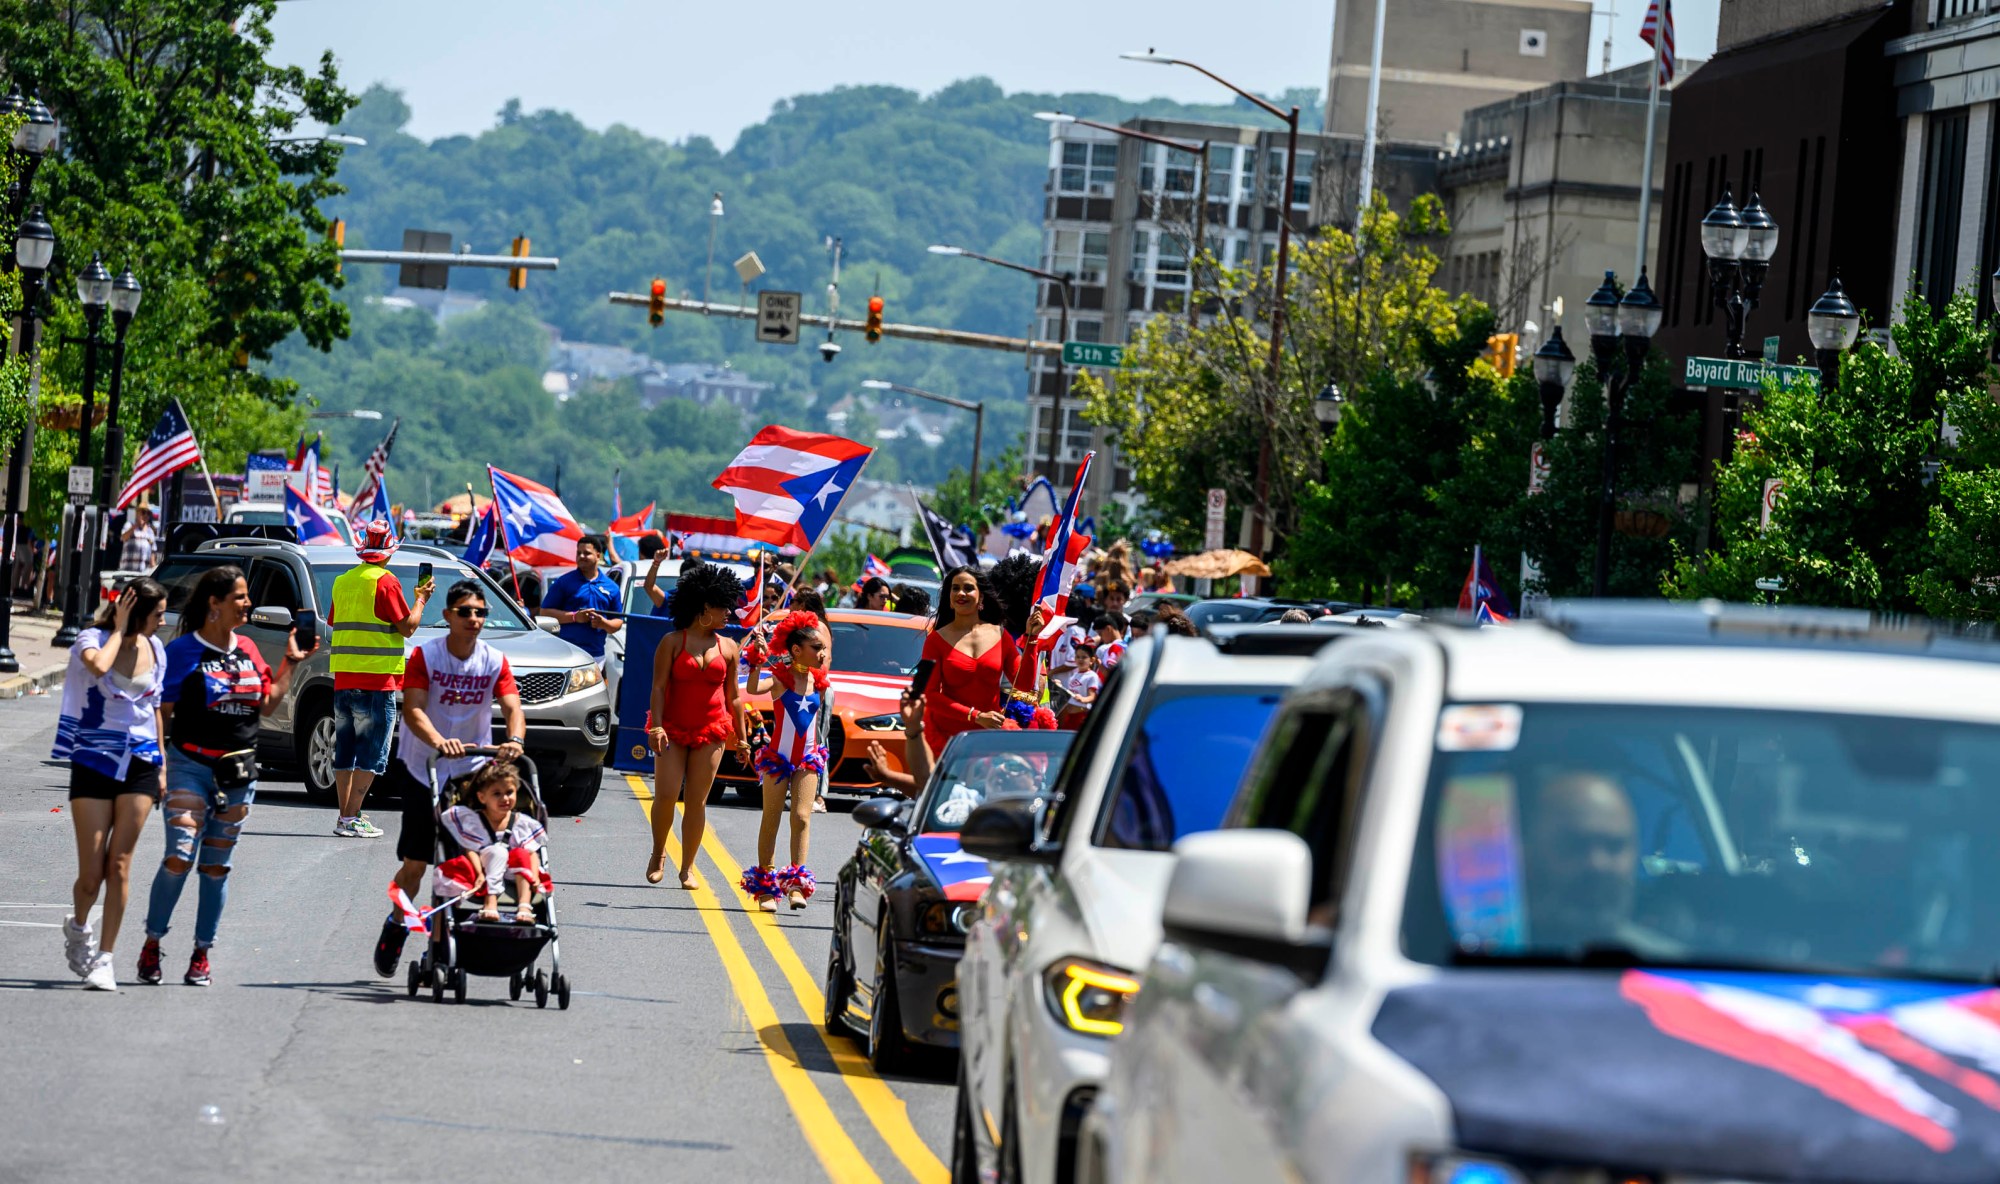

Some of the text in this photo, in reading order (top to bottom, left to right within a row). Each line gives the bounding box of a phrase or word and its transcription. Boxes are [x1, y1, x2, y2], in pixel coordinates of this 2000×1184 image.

[766, 296, 793, 309] ONE
[765, 310, 793, 322] WAY
[1073, 346, 1102, 362] 5th
[1686, 358, 1731, 384] Bayard
[1737, 363, 1777, 385] Rustin
[432, 669, 492, 690] PUERTO
